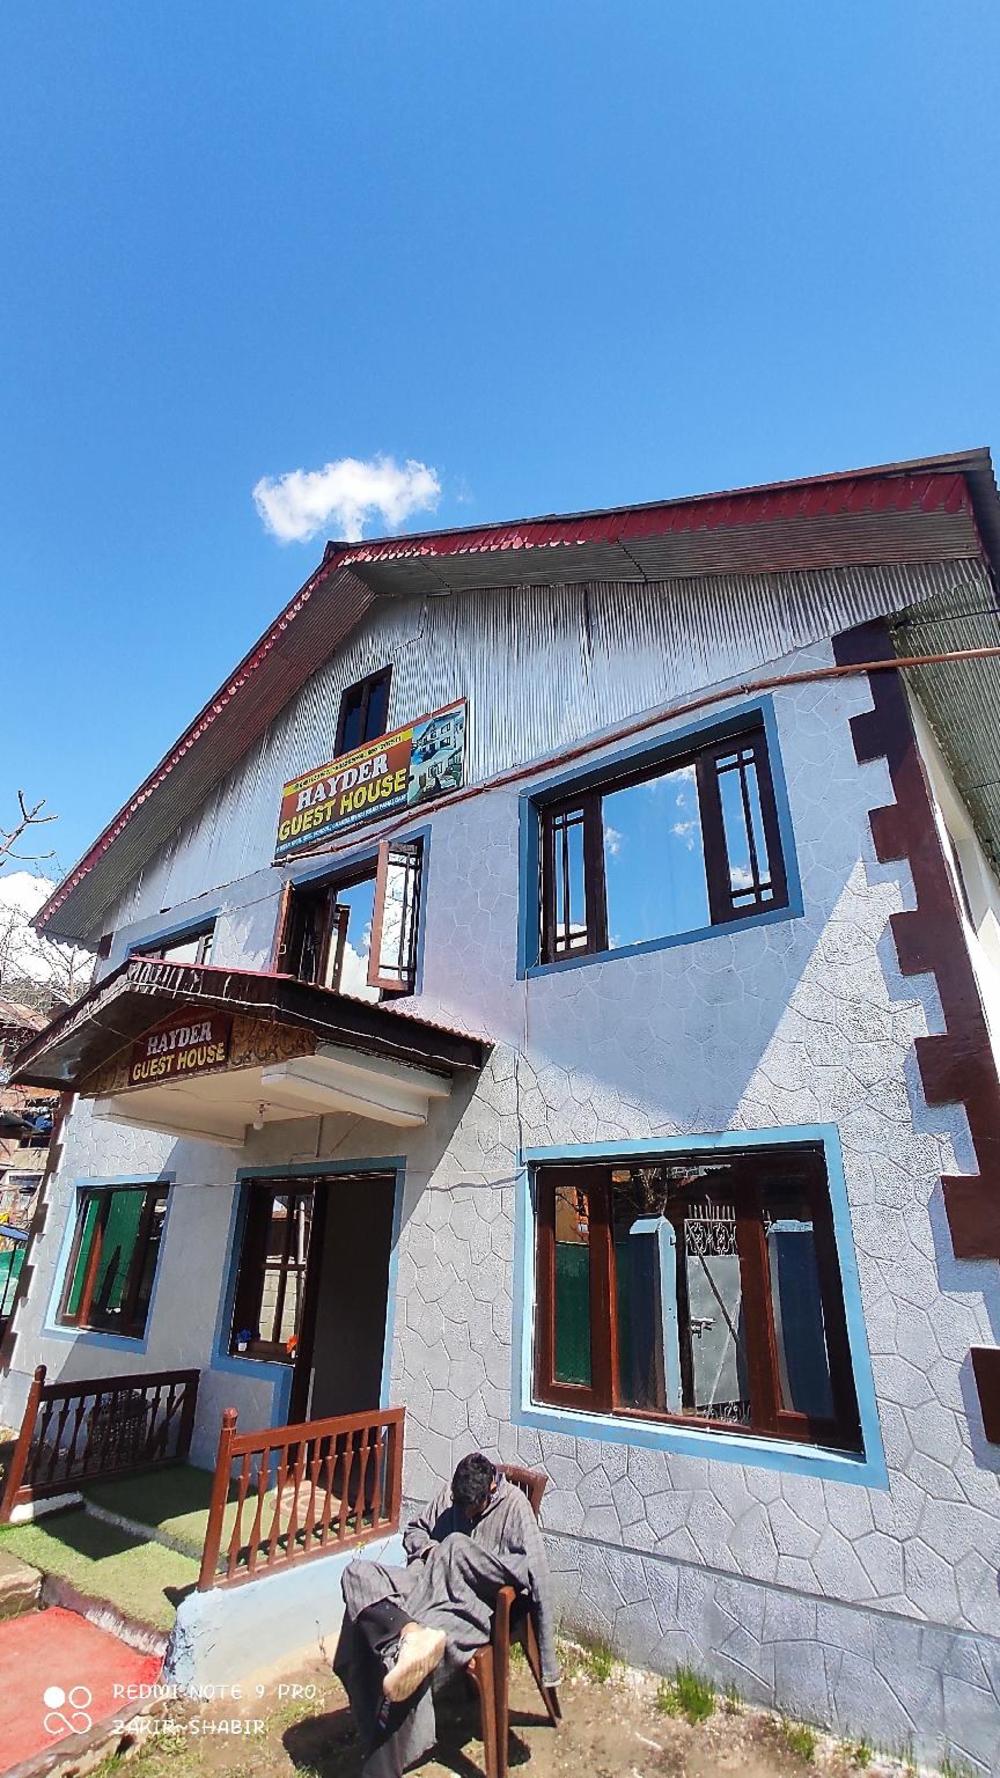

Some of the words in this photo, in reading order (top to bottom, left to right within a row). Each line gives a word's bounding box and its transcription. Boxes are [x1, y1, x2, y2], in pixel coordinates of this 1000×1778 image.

[278, 799, 336, 841] GUEST
[340, 768, 407, 816] HOUSE
[296, 753, 389, 812] HAYDER
[133, 1057, 173, 1080] GUEST
[177, 1043, 225, 1069] HOUSE
[147, 1022, 212, 1056] HAYDER
